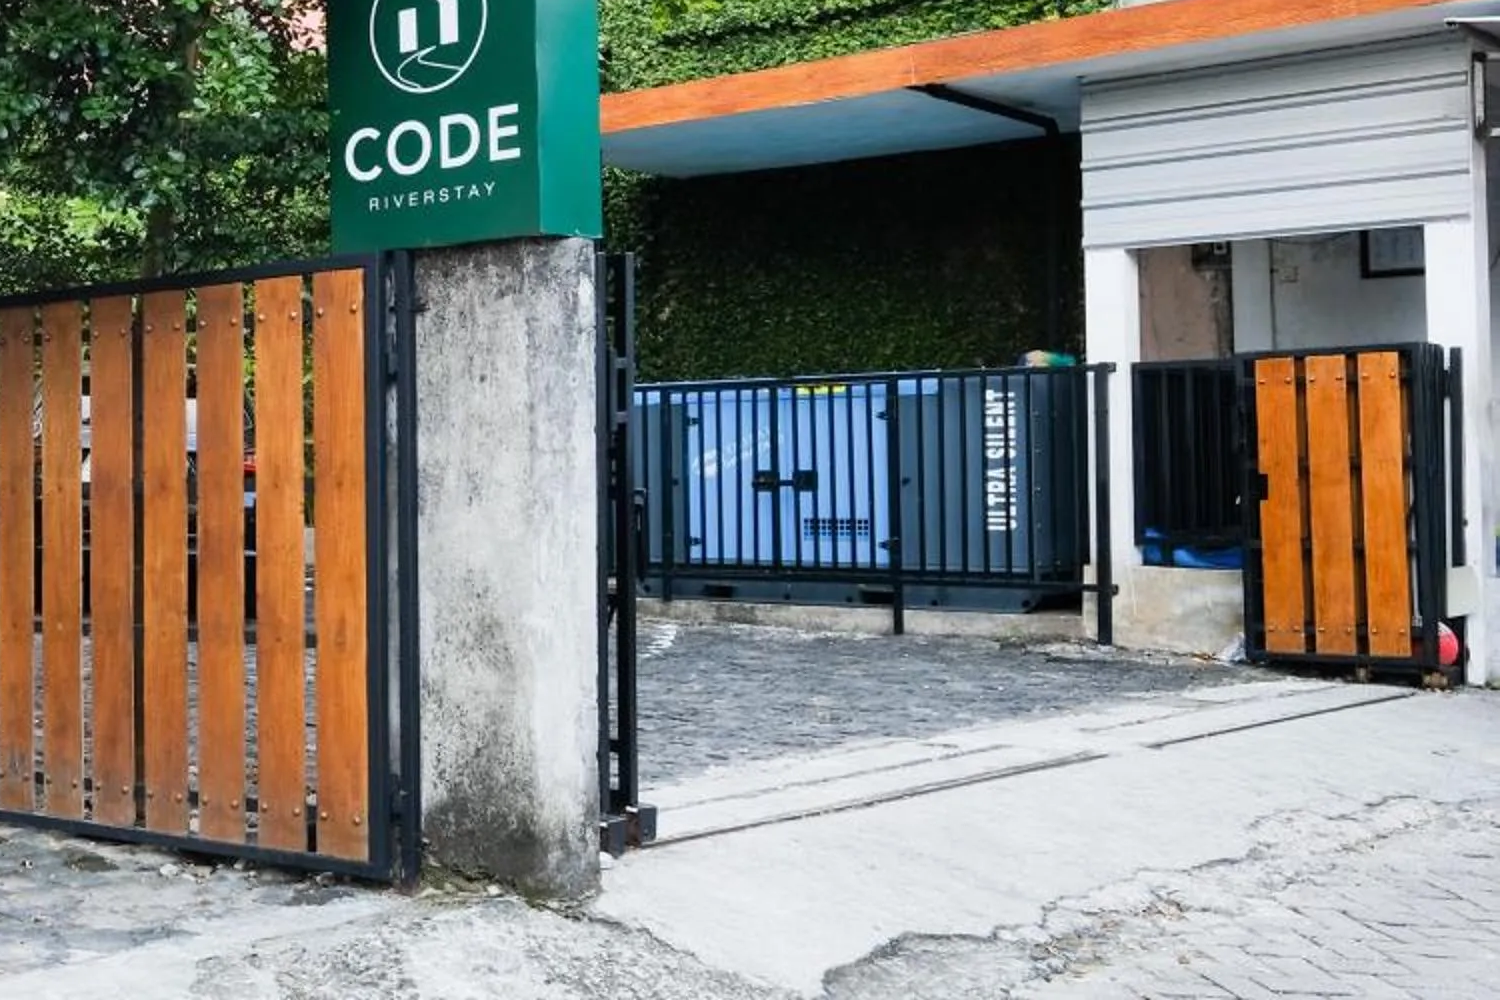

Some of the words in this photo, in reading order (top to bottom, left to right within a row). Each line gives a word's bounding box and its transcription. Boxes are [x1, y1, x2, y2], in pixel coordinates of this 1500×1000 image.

[344, 103, 521, 182] CODE
[369, 182, 496, 211] RIVERSTAY
[984, 389, 1017, 460] SILENT
[986, 466, 1018, 531] ULTRA
